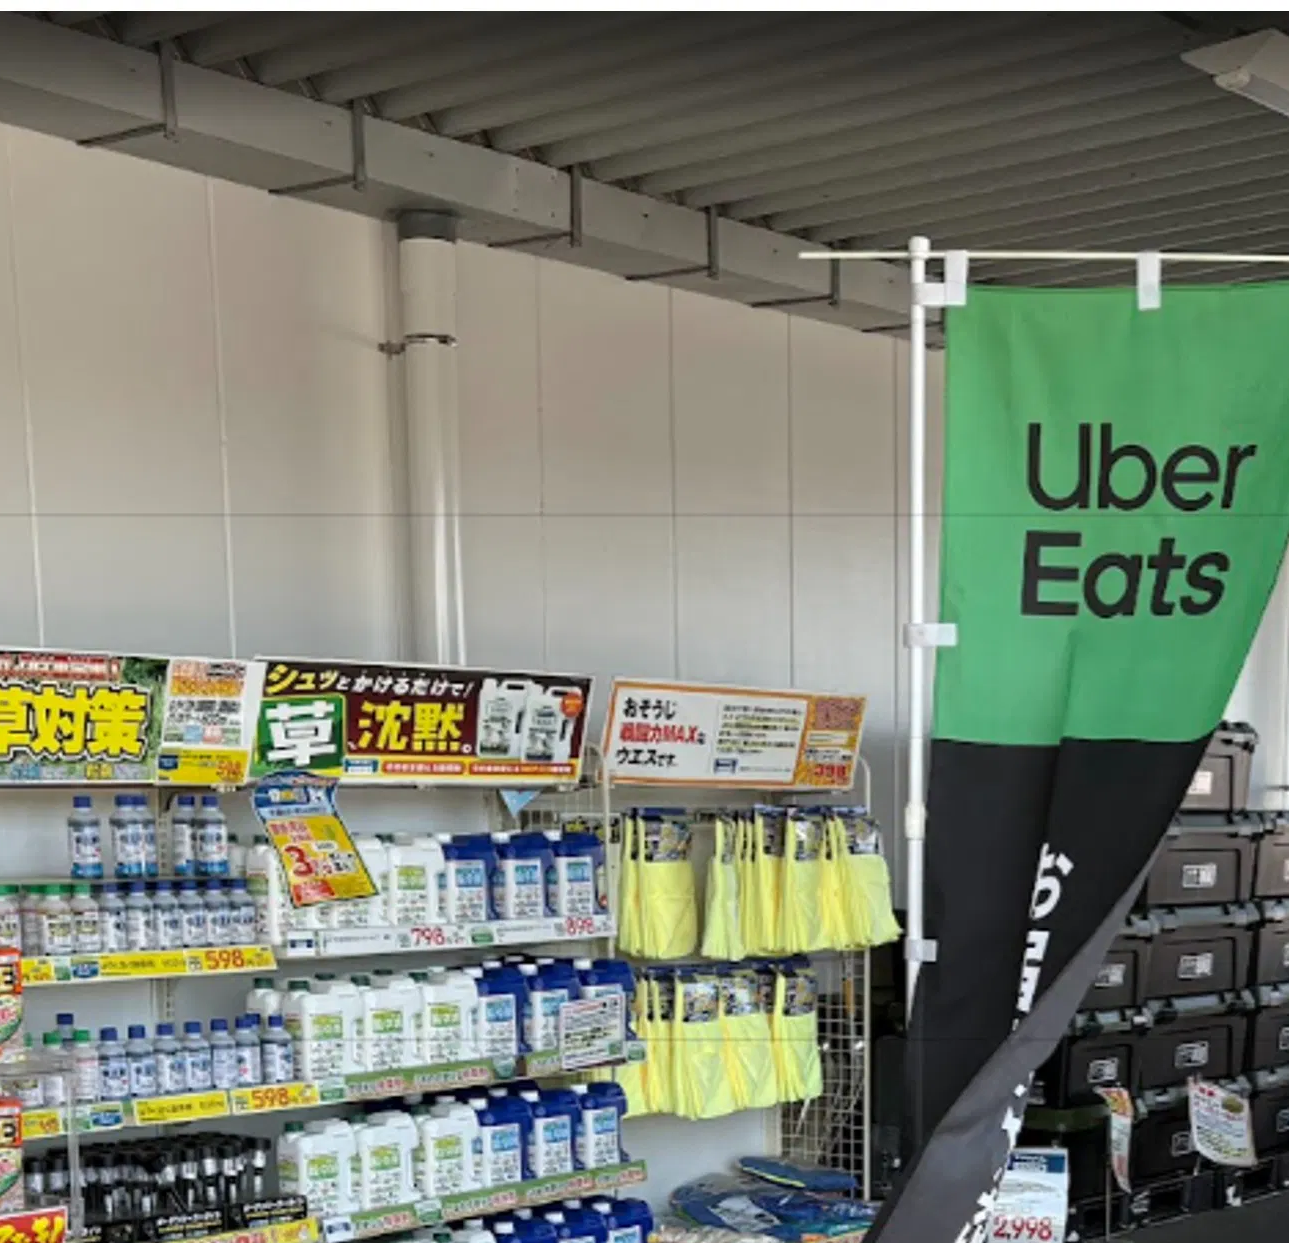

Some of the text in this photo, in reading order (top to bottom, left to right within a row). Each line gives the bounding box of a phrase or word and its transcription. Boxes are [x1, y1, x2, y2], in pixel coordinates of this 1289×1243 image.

[1026, 422, 1259, 513] Uber
[1020, 529, 1231, 619] Eats
[204, 950, 245, 970] 598
[250, 1087, 291, 1110] 598
[993, 1214, 1053, 1240] 2,998
